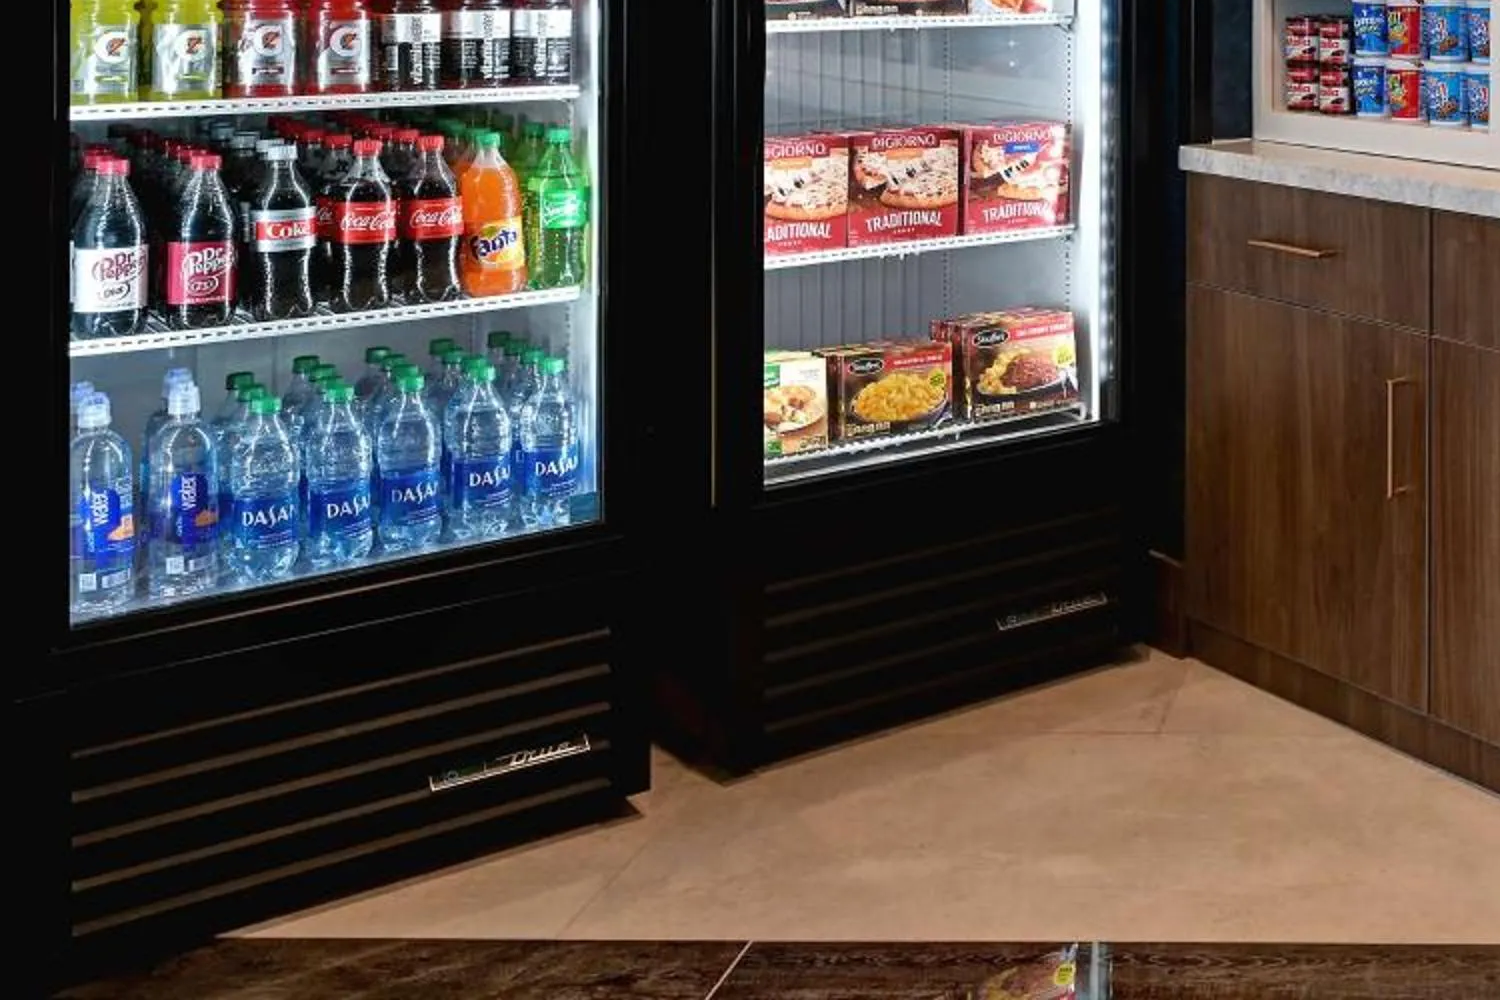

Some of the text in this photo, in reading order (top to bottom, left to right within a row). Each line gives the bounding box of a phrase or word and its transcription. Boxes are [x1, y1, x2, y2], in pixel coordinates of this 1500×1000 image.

[765, 143, 826, 157] GIORNO
[340, 211, 396, 231] Coca-Cola
[410, 205, 462, 228] Coca-Cola
[865, 210, 943, 233] TRADITIONAL
[266, 221, 312, 240] Coke
[767, 223, 832, 242] ADITIONAL
